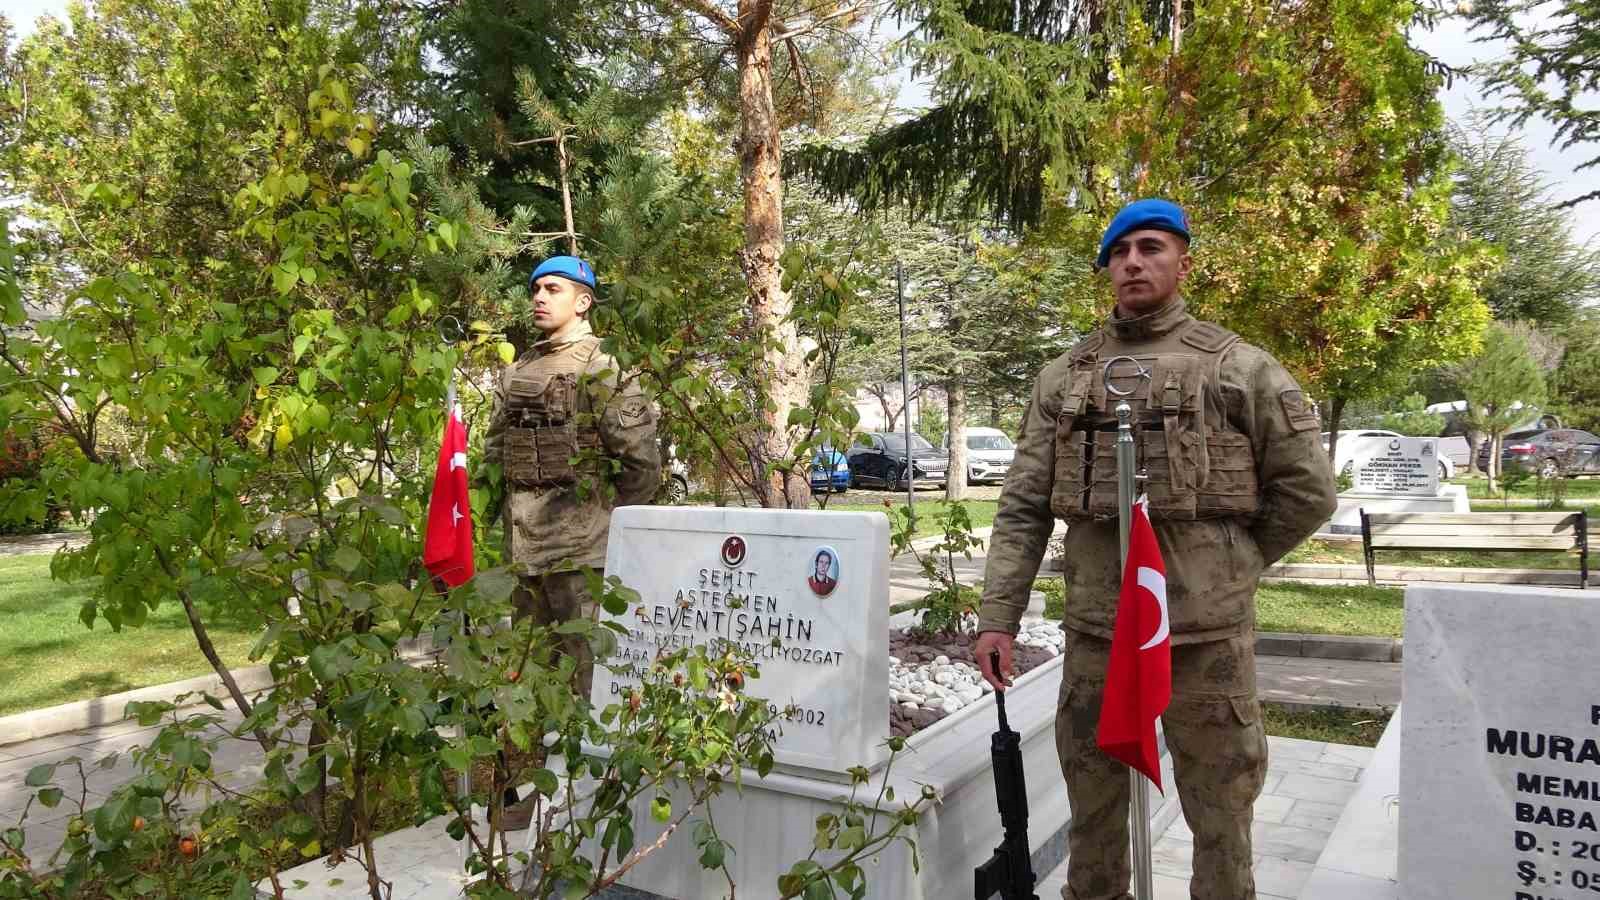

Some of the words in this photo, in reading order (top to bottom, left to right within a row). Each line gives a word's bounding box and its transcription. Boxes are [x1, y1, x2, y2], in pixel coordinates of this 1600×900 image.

[698, 568, 758, 588] ŞEHİT
[736, 612, 812, 641] ŞAHİN
[1486, 728, 1600, 765] MURA
[1515, 802, 1598, 832] BABA
